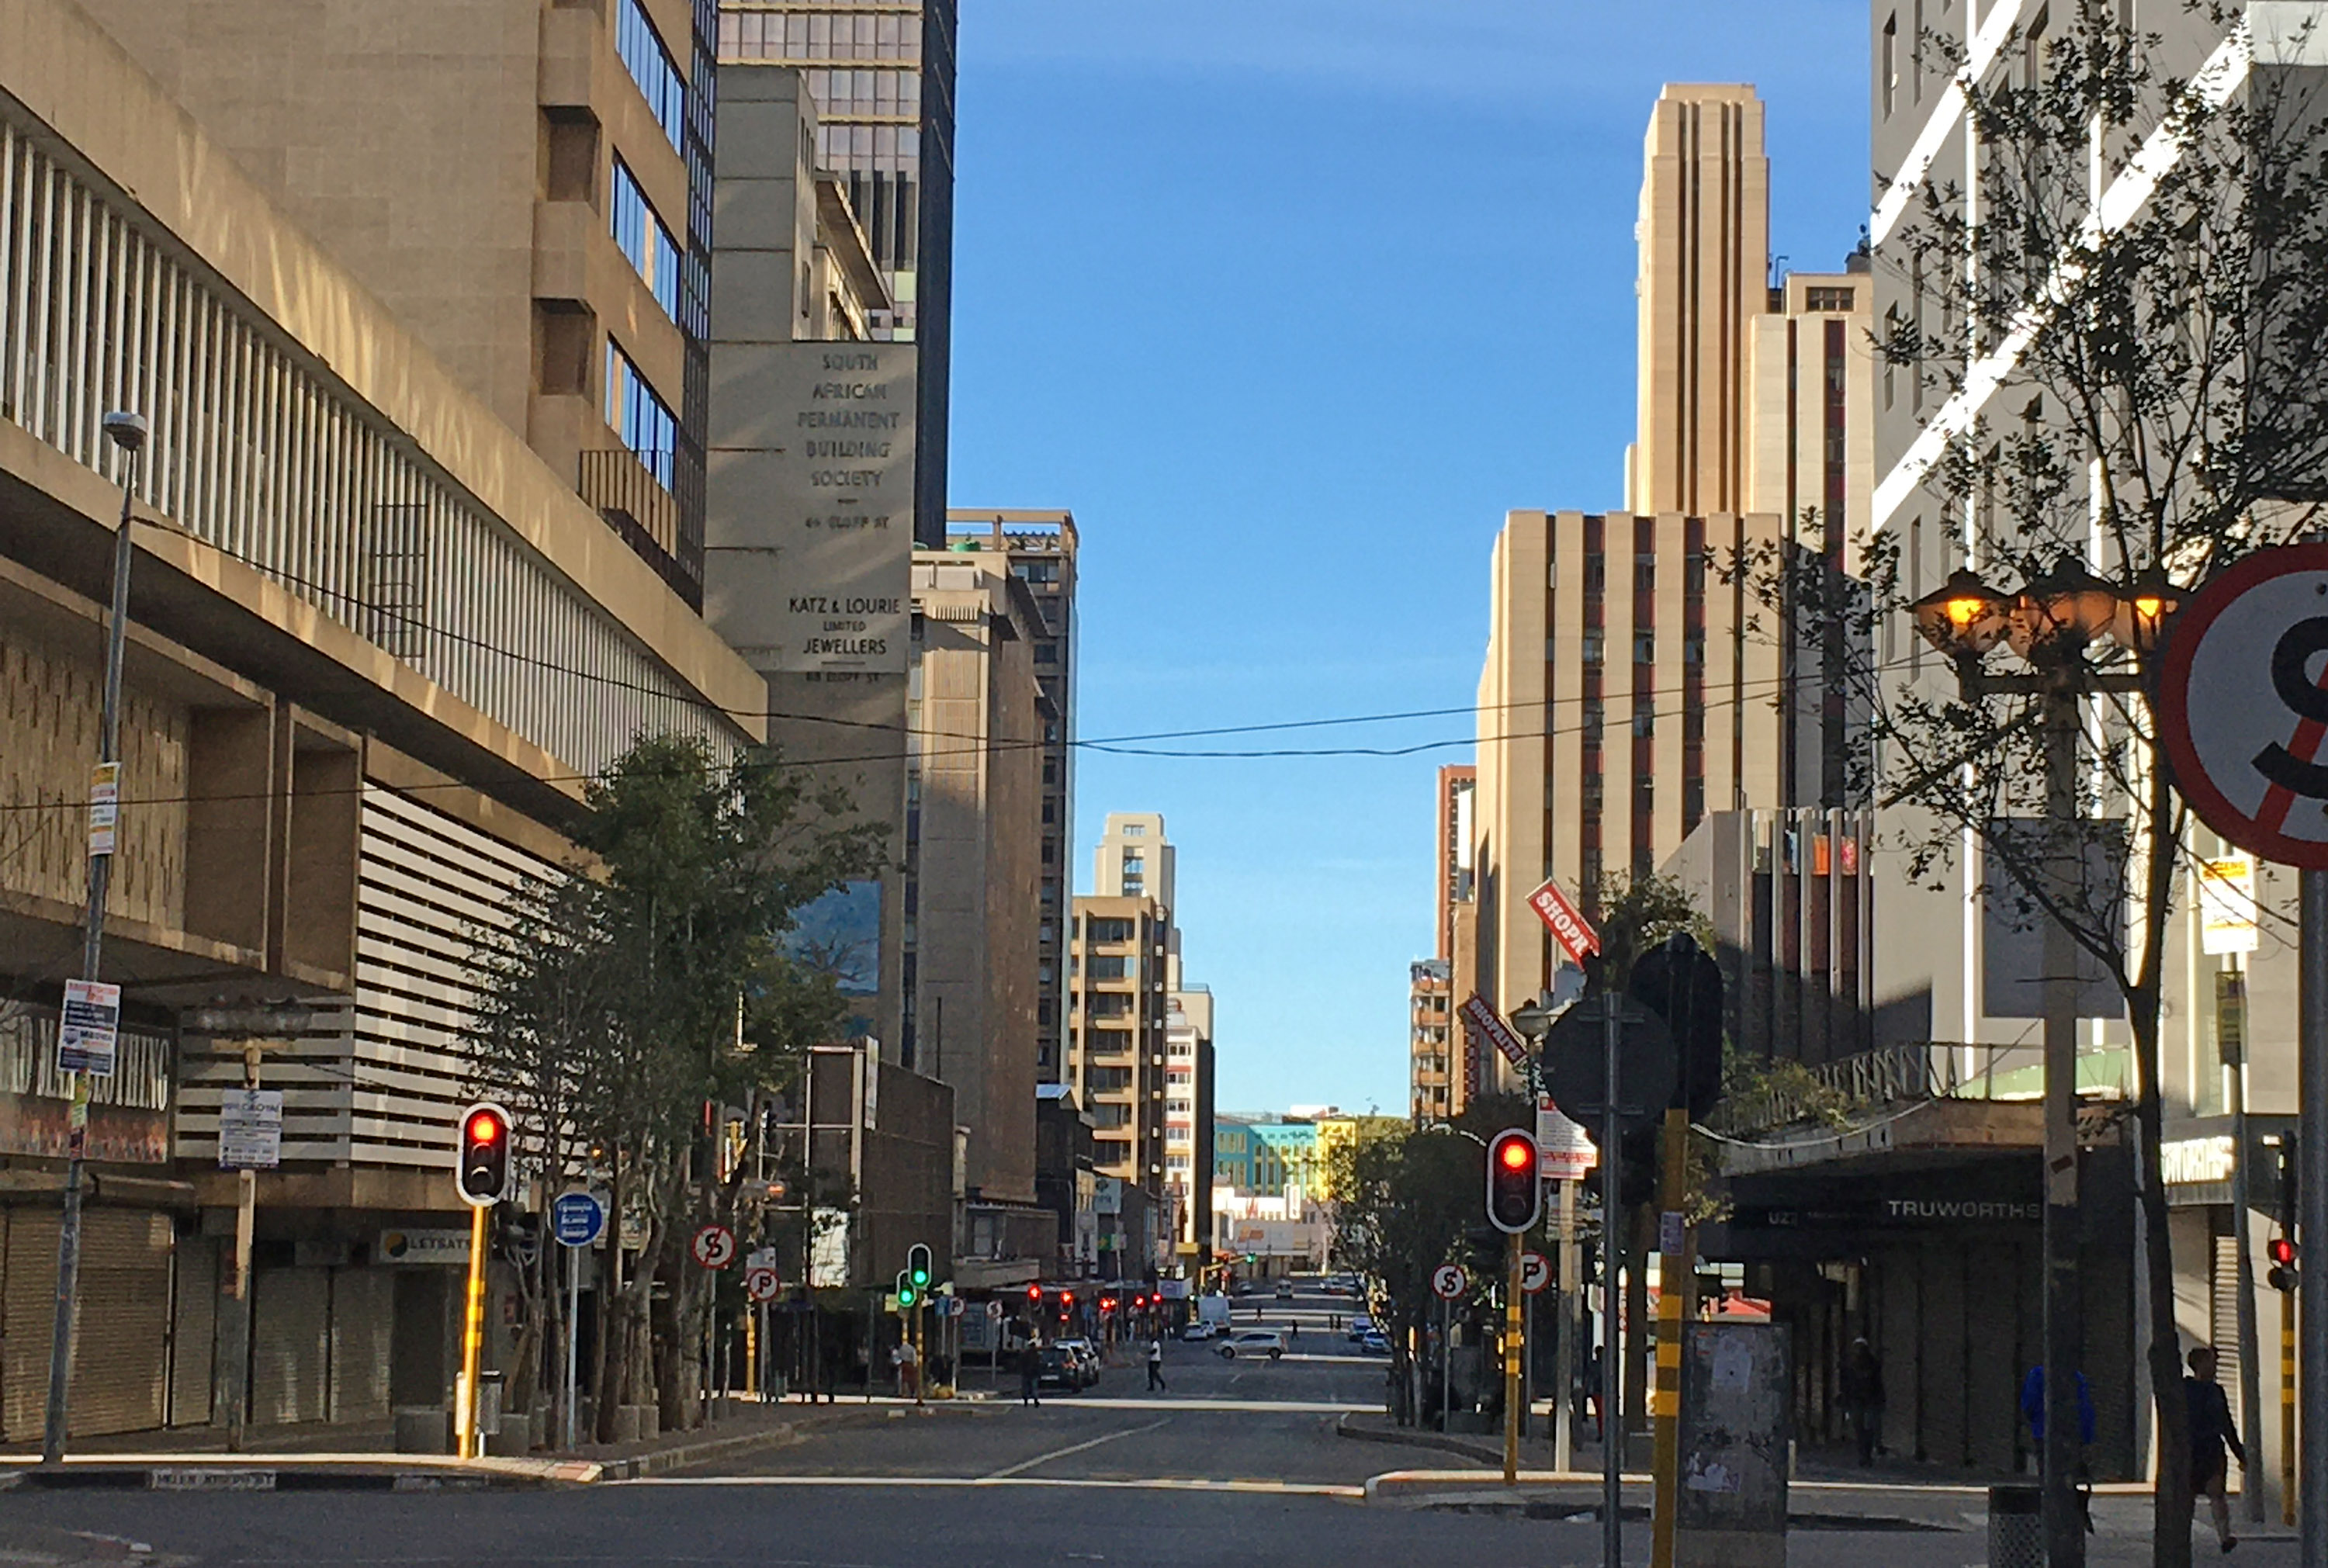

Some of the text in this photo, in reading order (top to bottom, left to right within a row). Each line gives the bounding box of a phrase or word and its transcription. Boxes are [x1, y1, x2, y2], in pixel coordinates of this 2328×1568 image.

[823, 354, 878, 371] SOUTH
[812, 382, 887, 400] AFRICAN
[798, 411, 900, 428] PERMANENT
[805, 441, 891, 458] BUILDING
[811, 470, 883, 487] SOCIETY
[789, 597, 900, 614] KATZ & LOURIE
[823, 621, 866, 632] LIMITED
[803, 638, 886, 655] JEWELLERS
[1536, 891, 1595, 957] SHOPR
[1469, 999, 1522, 1061] SHOPRITE
[1888, 1200, 2042, 1219] TRUWORTHS
